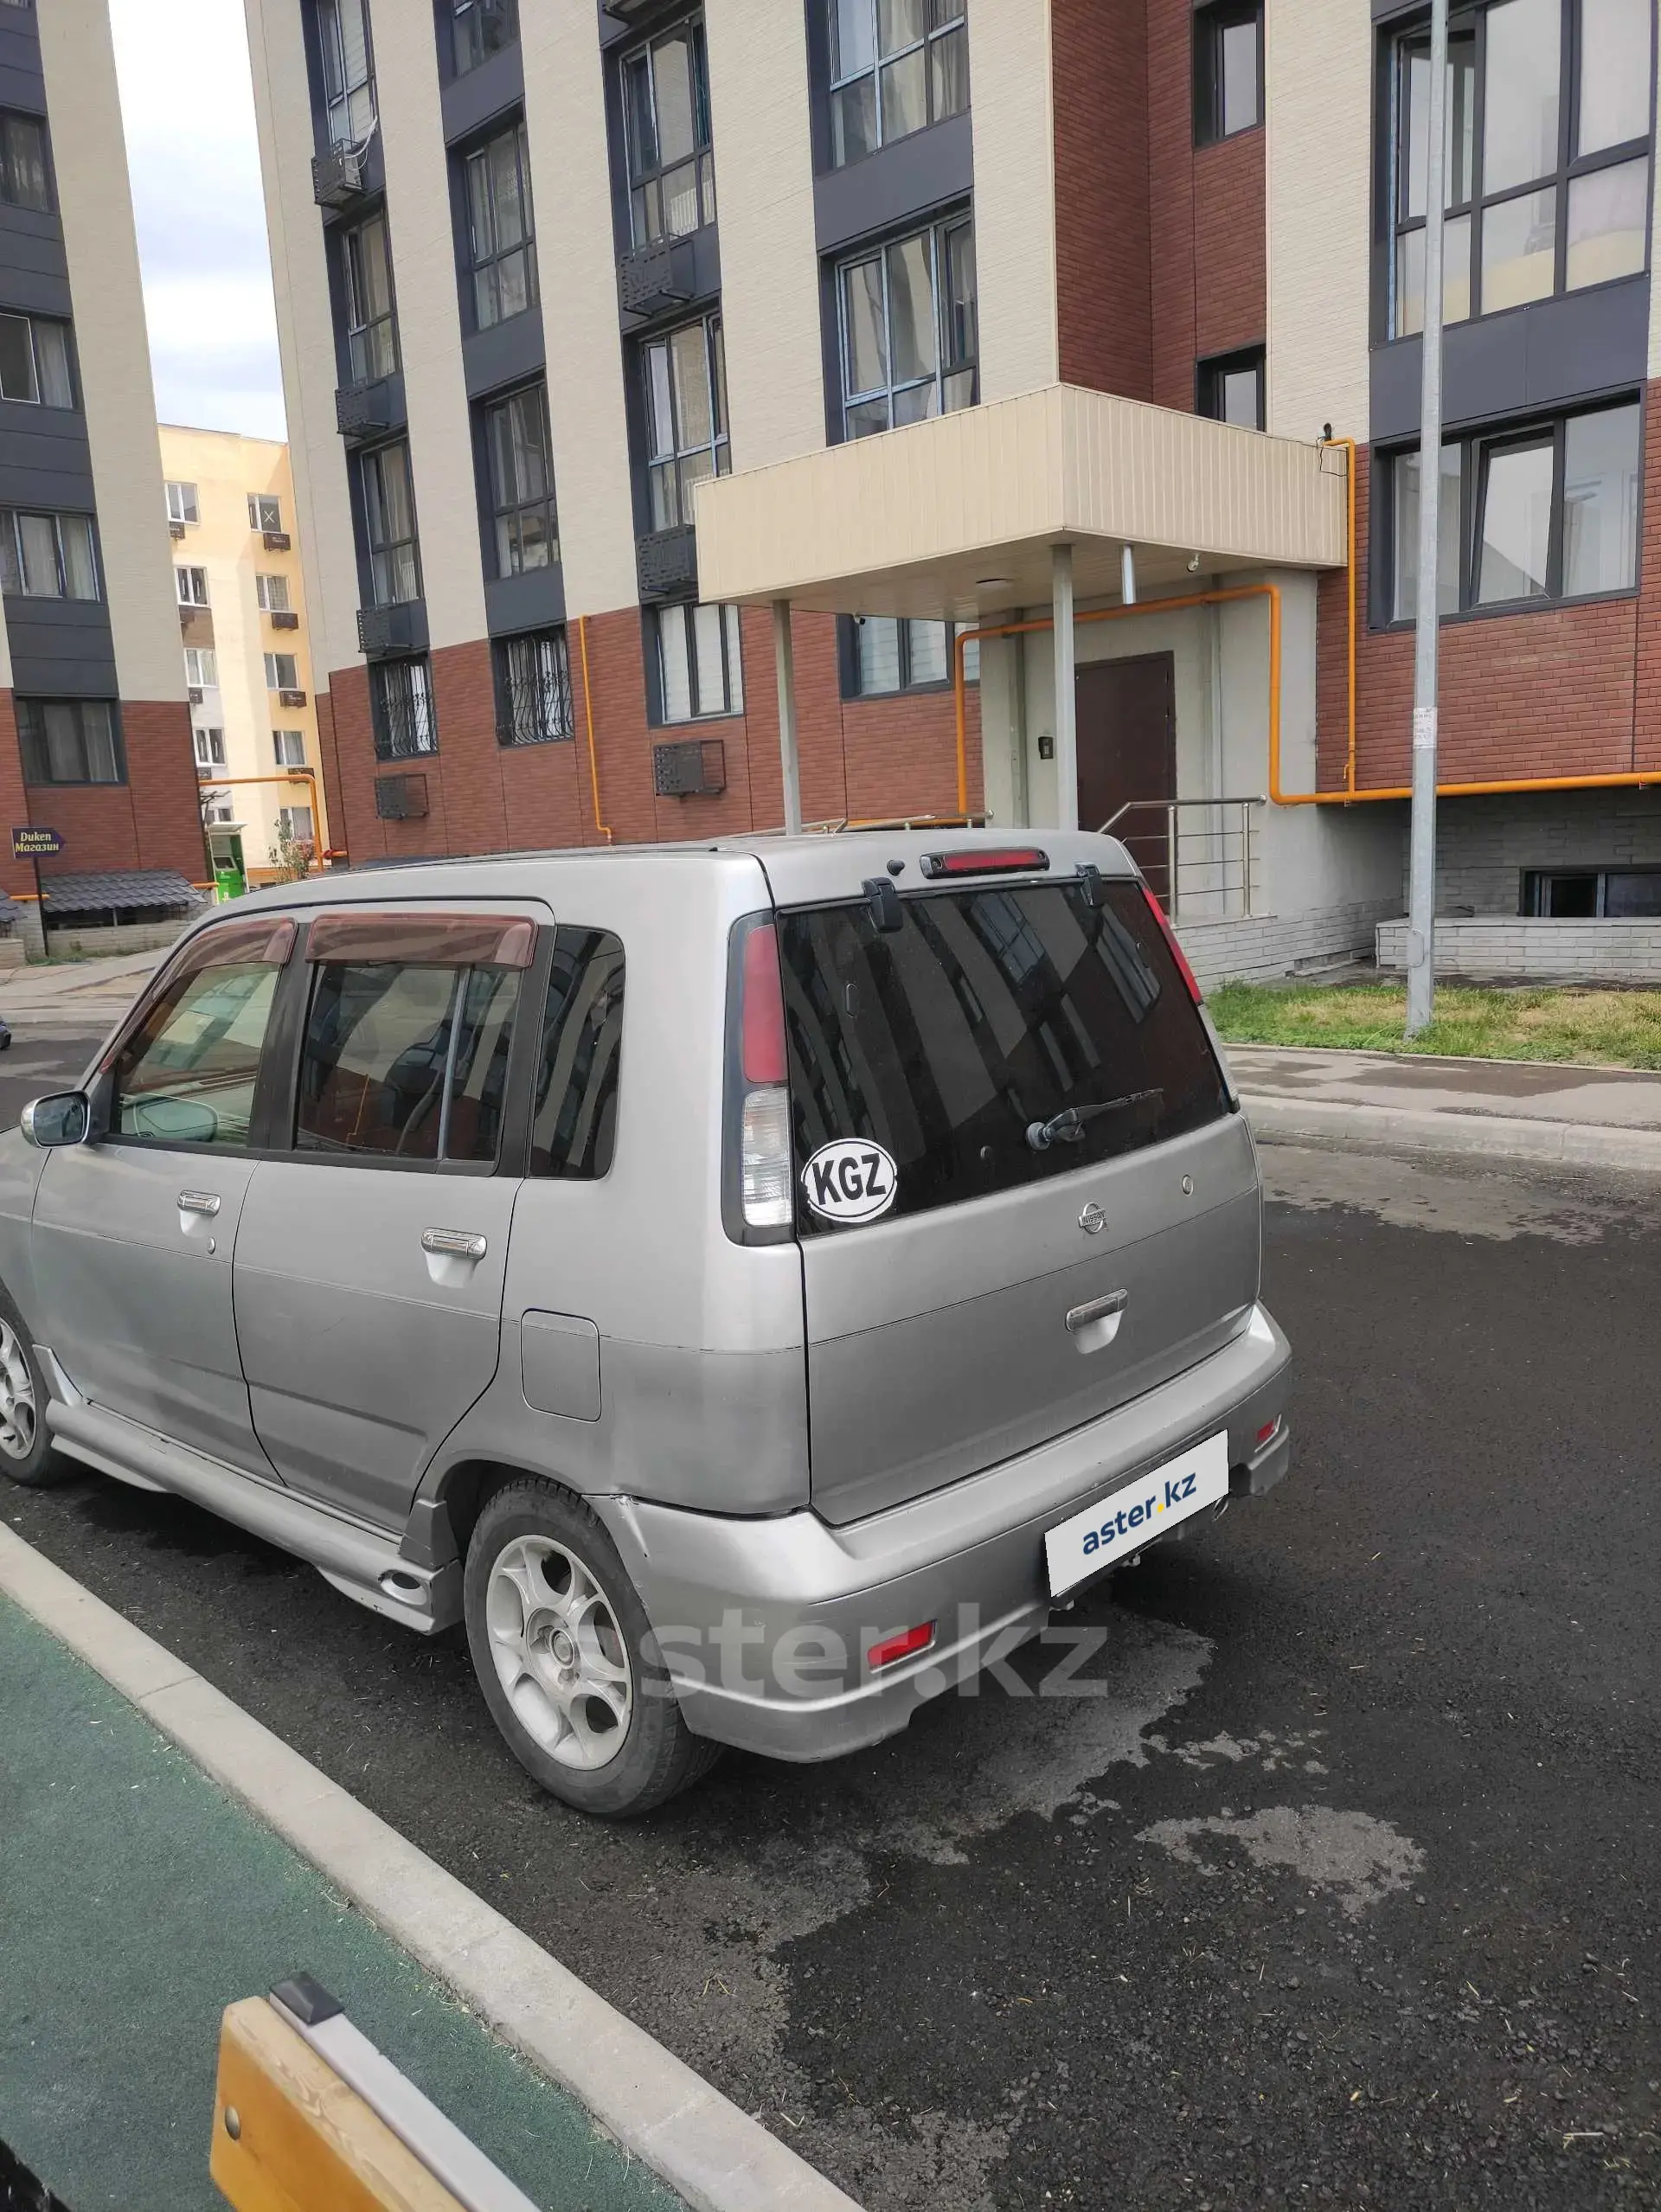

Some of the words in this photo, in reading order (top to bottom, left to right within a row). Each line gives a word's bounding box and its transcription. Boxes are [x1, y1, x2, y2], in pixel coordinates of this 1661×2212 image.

[20, 831, 51, 842] Duken
[15, 843, 60, 852] Магазин
[811, 1152, 887, 1205] KGZ
